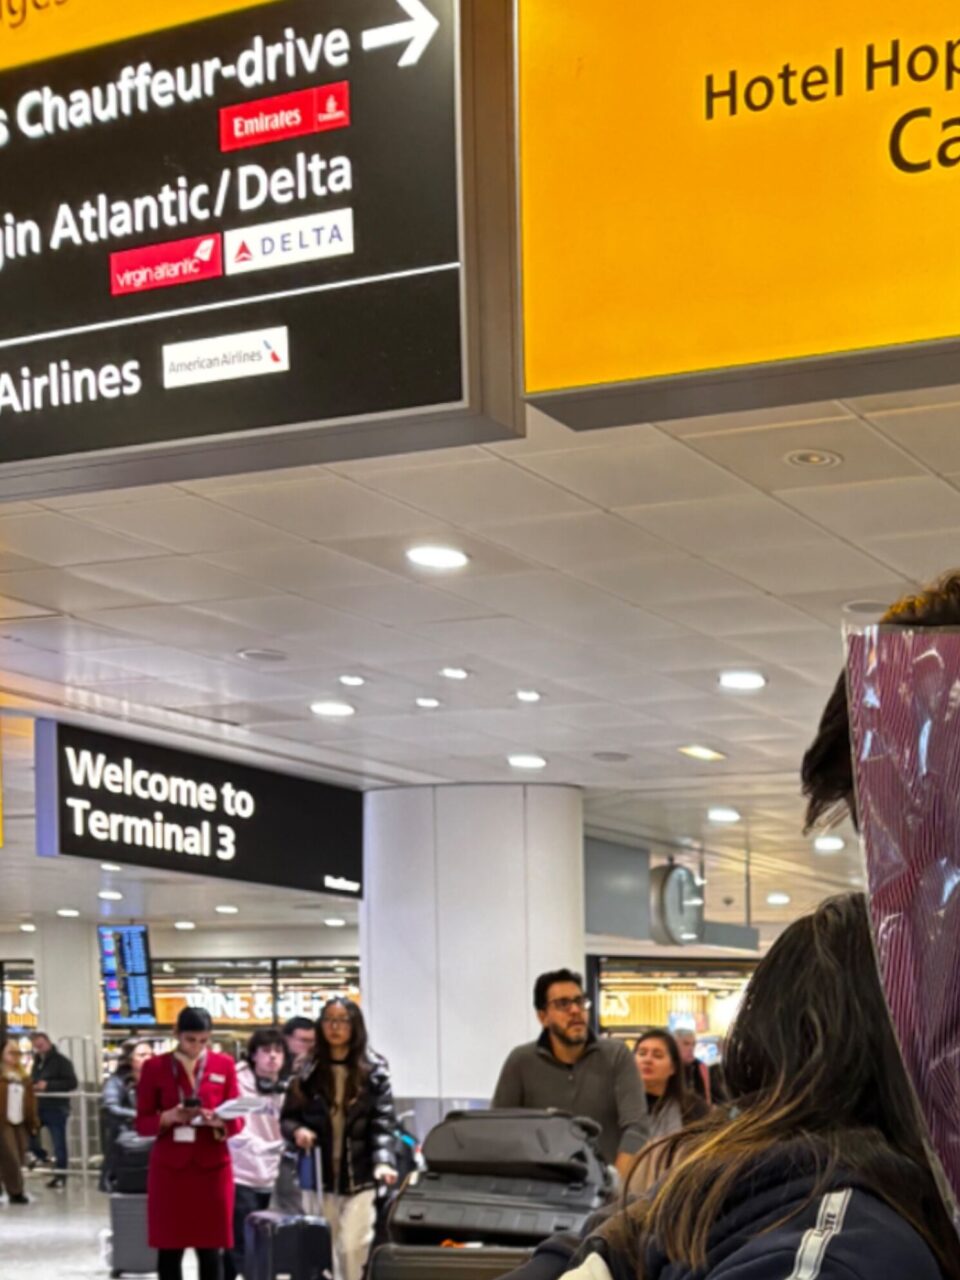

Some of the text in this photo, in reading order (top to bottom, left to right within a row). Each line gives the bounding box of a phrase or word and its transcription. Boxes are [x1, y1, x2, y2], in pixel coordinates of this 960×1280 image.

[16, 27, 351, 138] Chauffeur-drive
[705, 47, 844, 120] Hotel
[232, 108, 302, 138] Emirates
[261, 223, 344, 256] DELTA
[64, 746, 255, 818] Welcome to
[65, 797, 236, 861] Terminal 3
